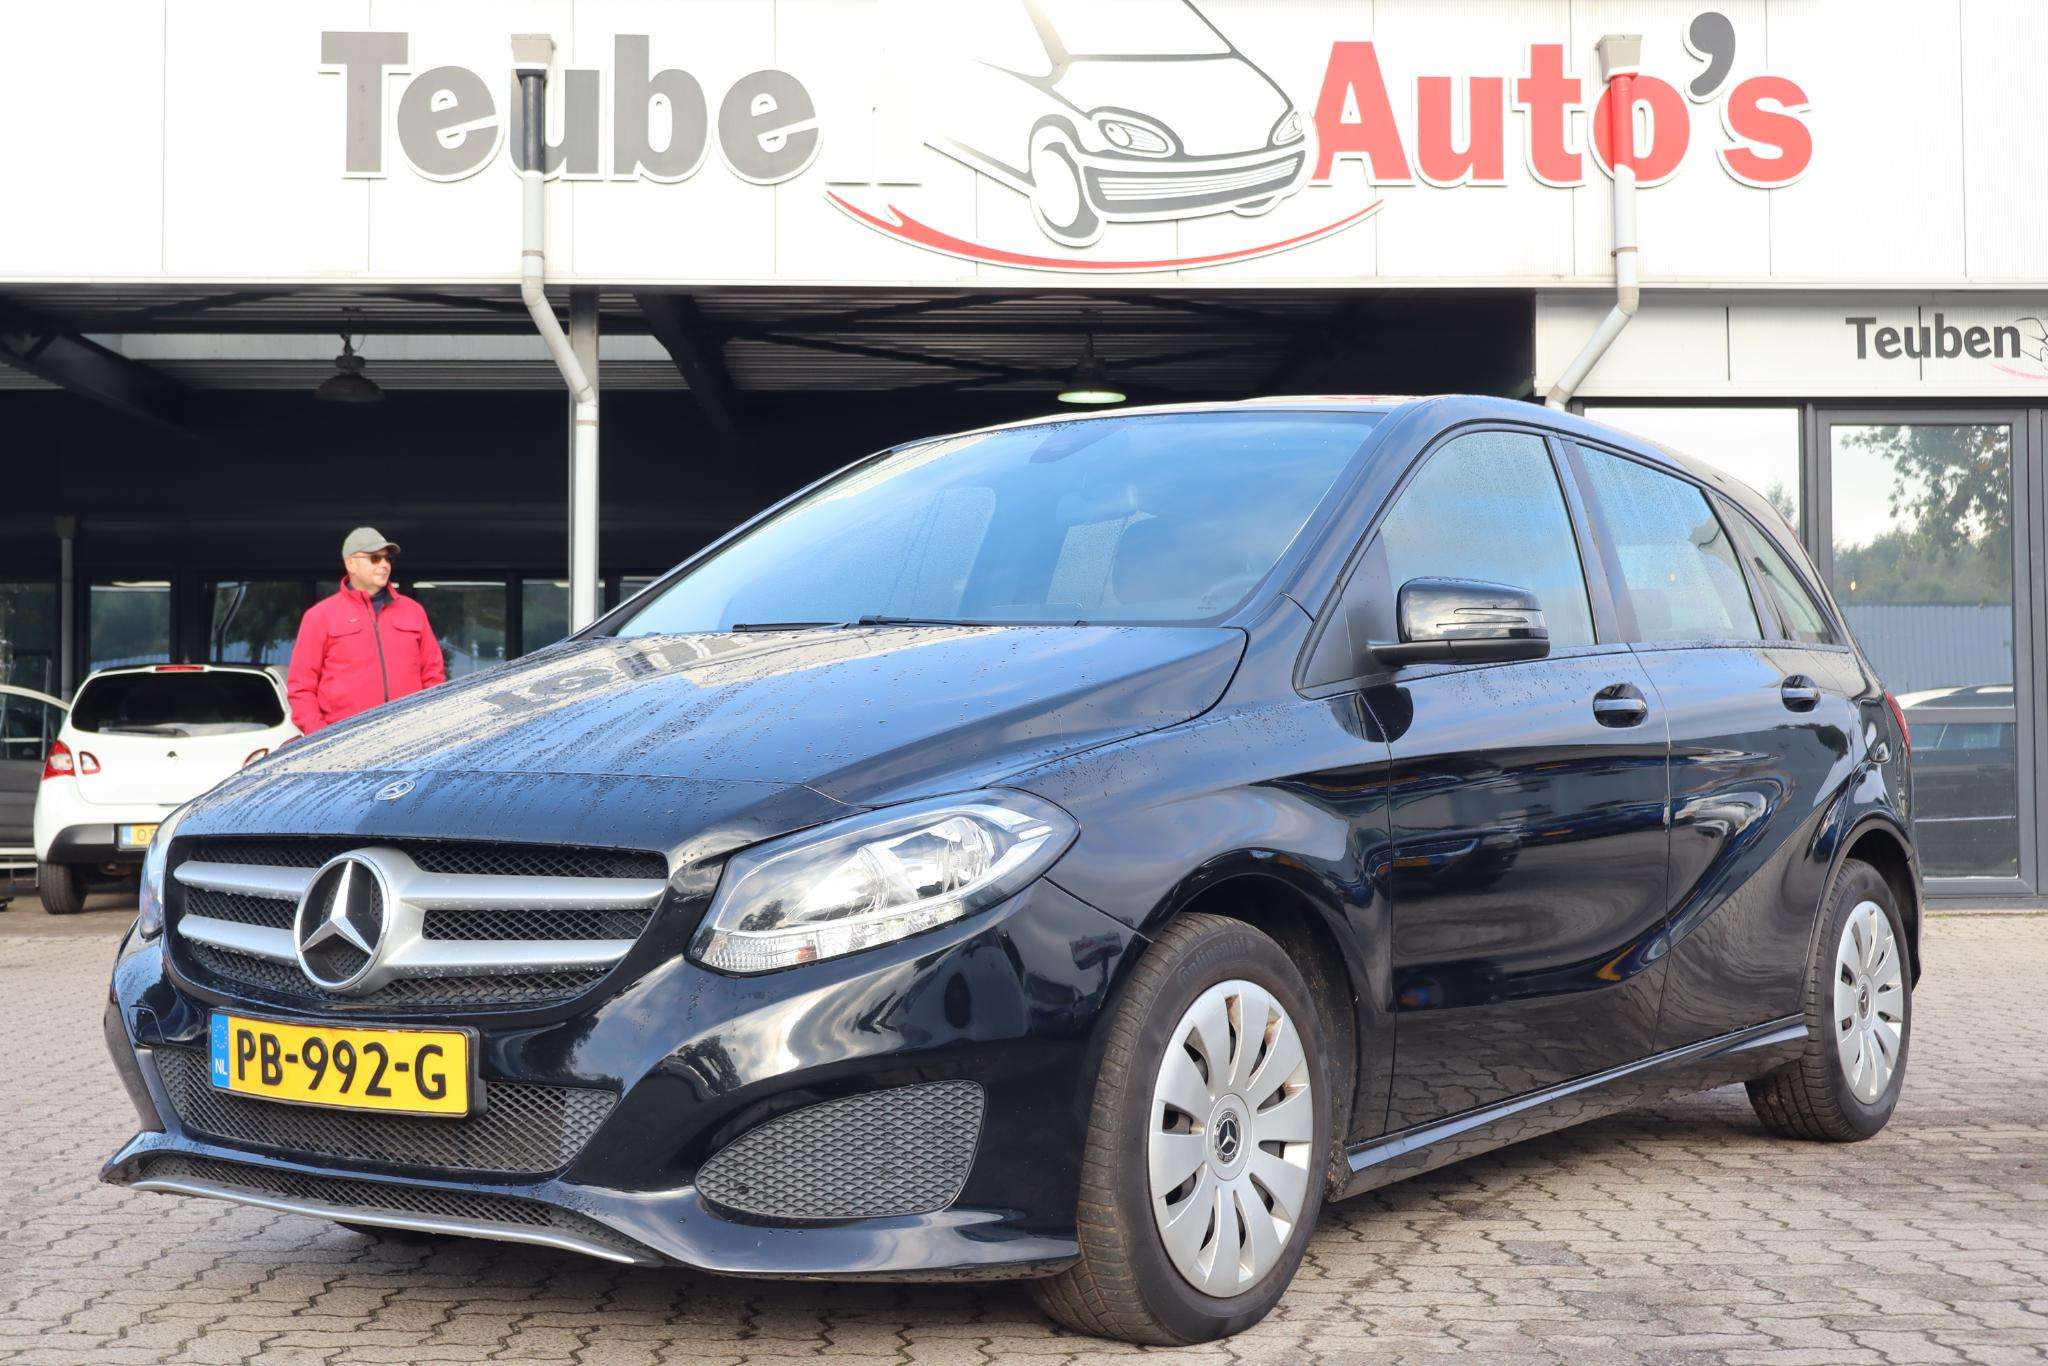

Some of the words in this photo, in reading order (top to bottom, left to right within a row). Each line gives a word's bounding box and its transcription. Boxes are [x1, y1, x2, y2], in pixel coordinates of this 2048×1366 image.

[1311, 11, 1814, 183] Auto's
[1845, 312, 2021, 360] Teuben
[214, 1057, 229, 1076] NL
[236, 1028, 448, 1101] PB-992-G
